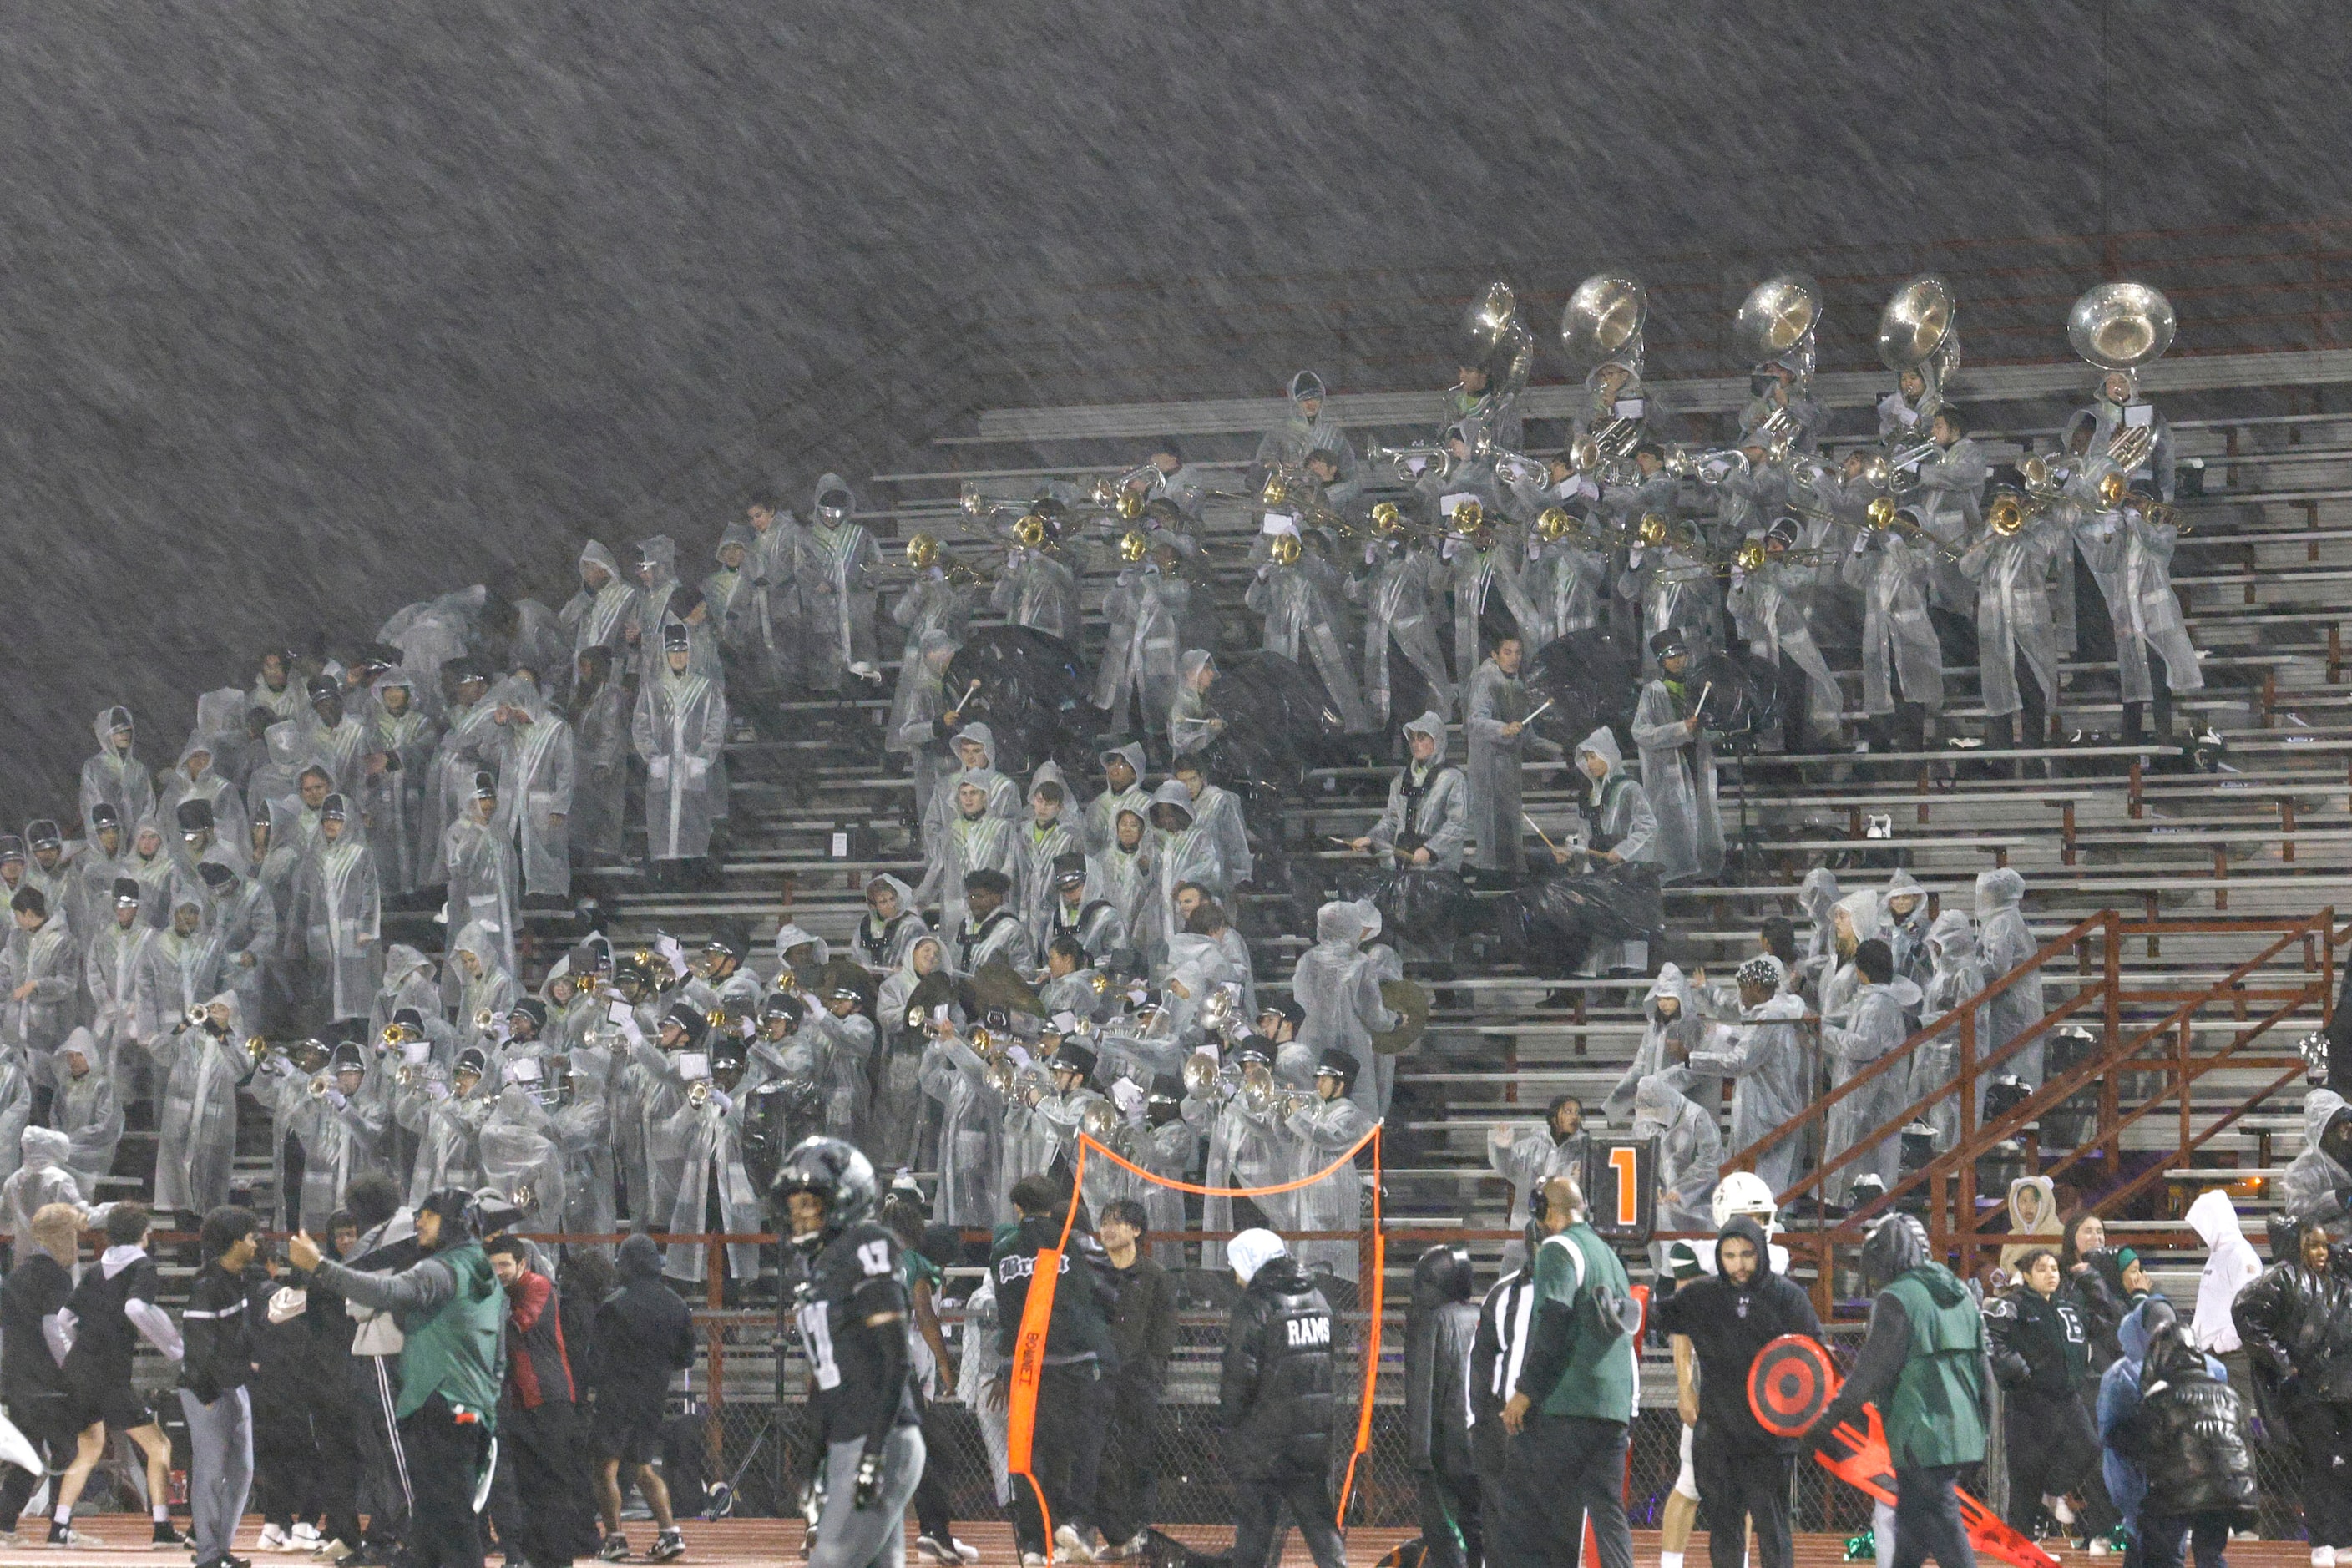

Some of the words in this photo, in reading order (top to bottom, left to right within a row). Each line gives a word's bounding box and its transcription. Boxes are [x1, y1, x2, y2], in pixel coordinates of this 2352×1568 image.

[1609, 1147, 1637, 1225] 1
[857, 1239, 891, 1275] 17
[1287, 1317, 1331, 1346] RAMS
